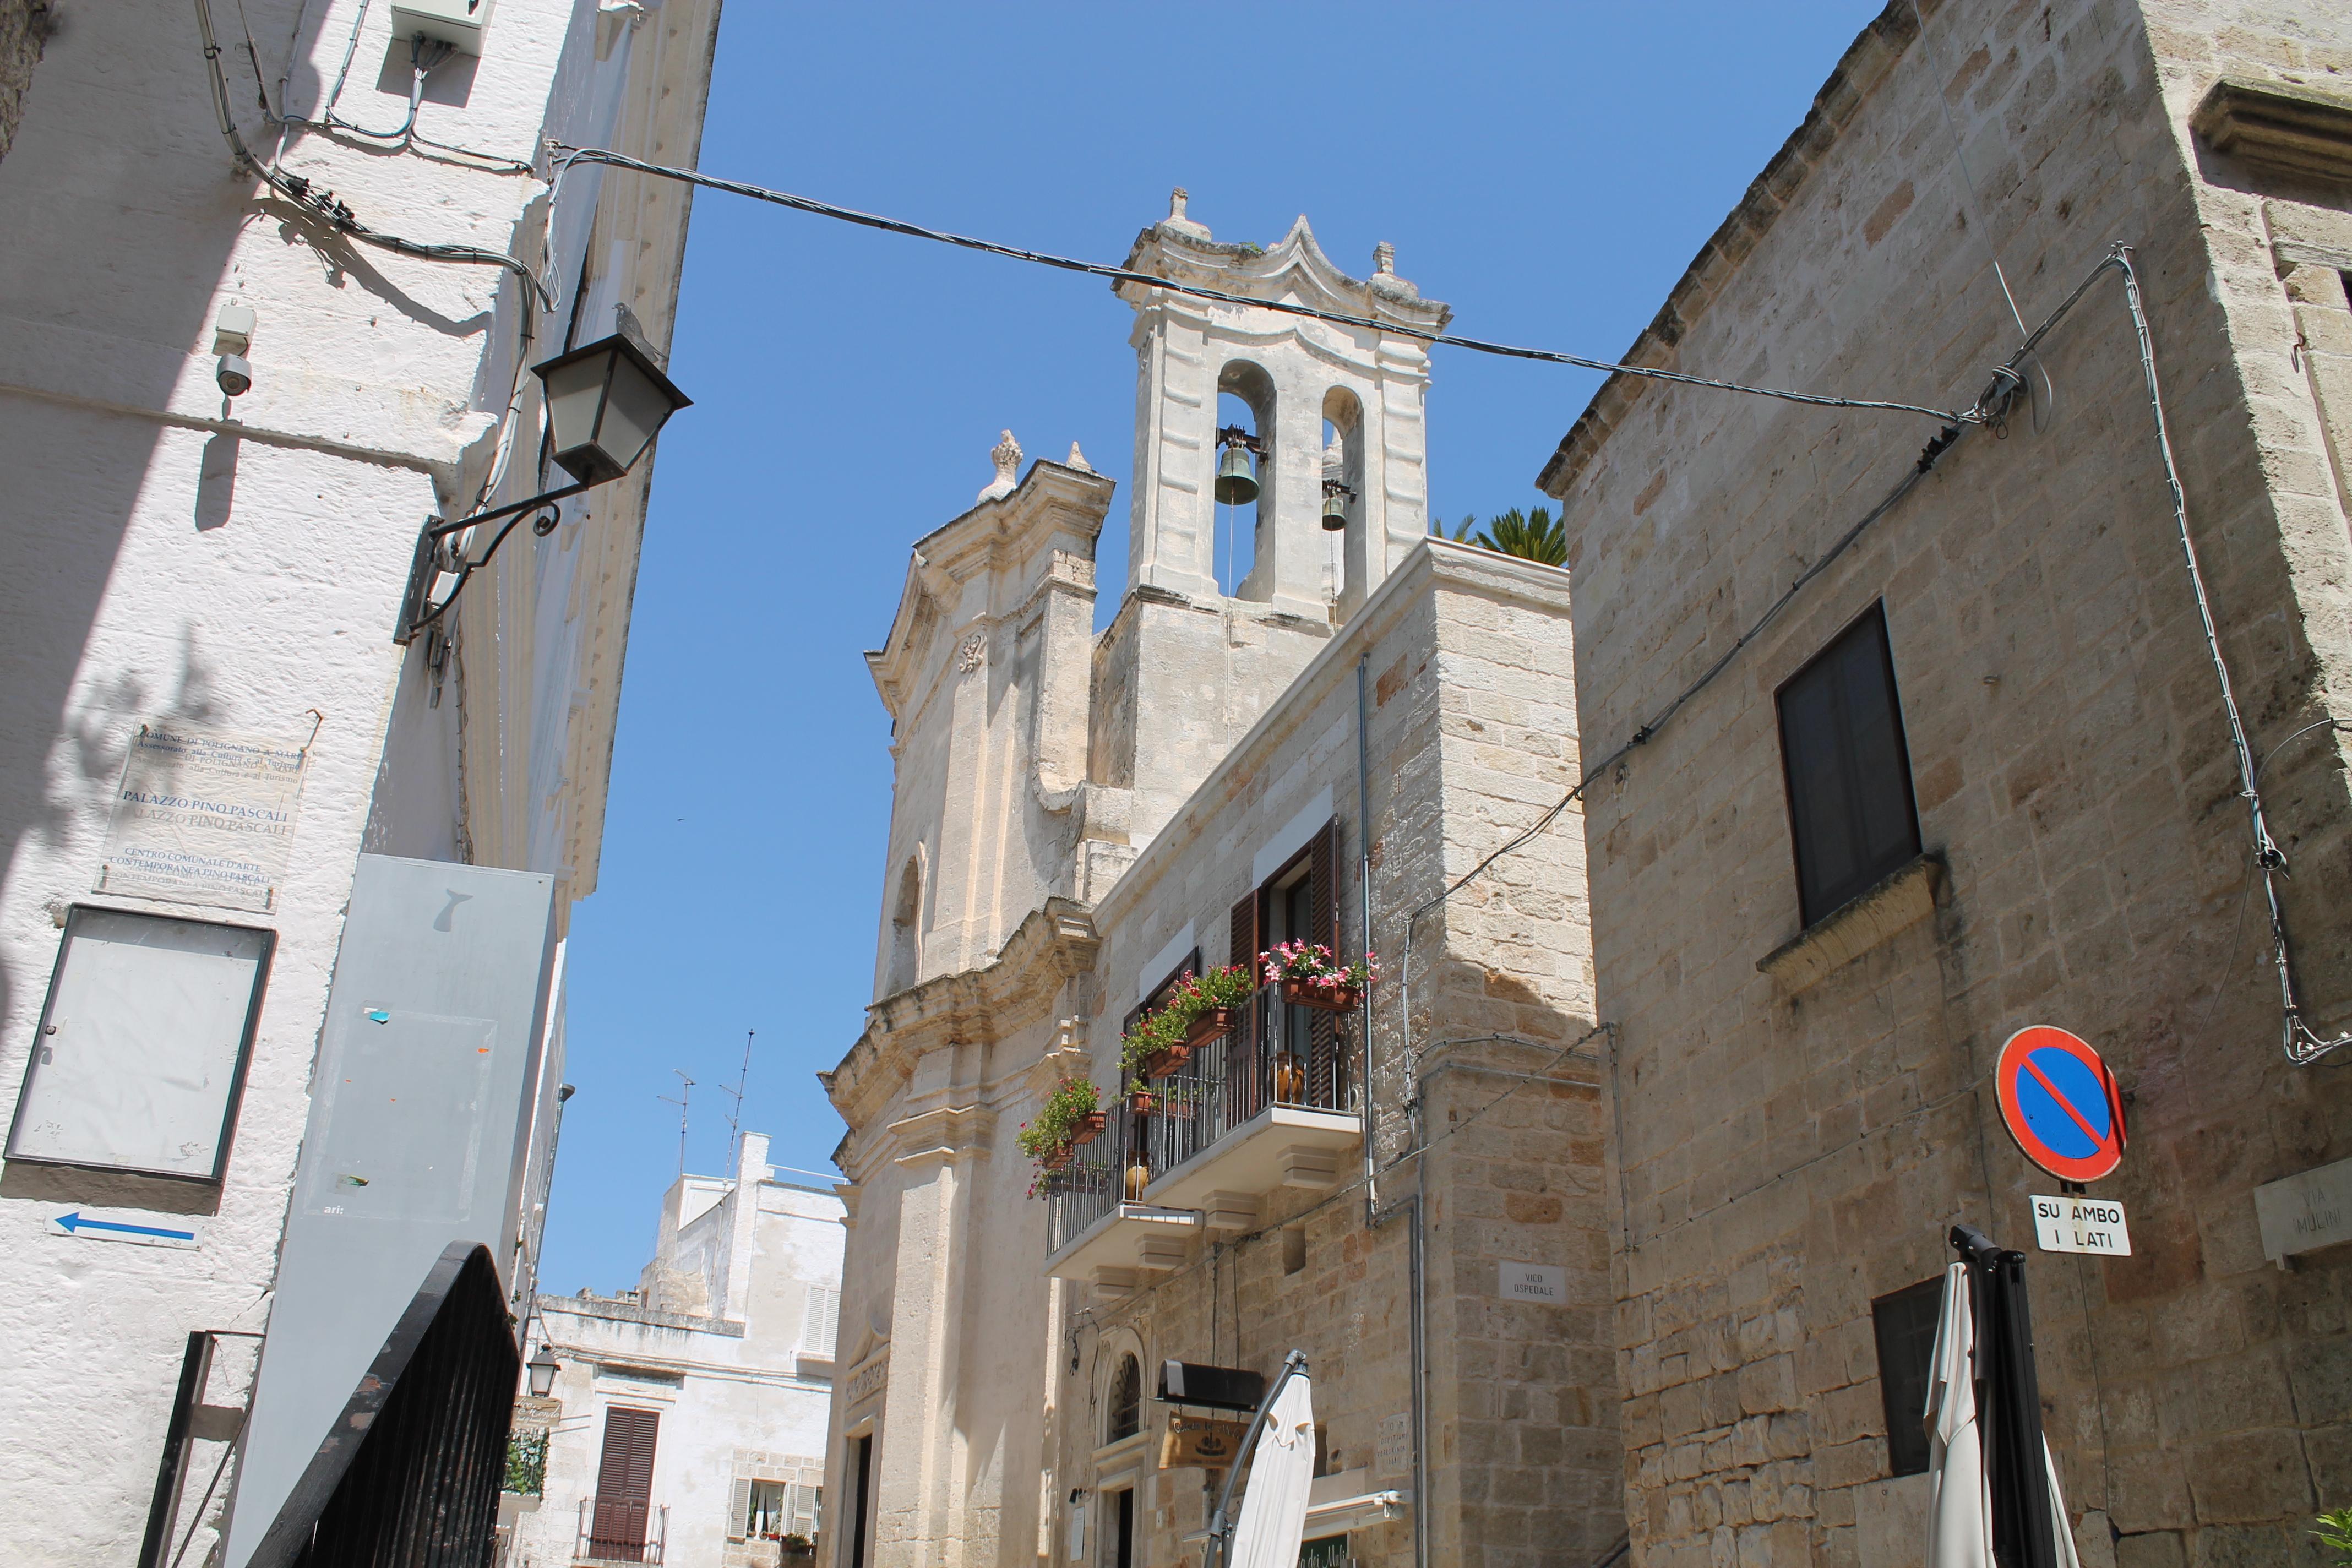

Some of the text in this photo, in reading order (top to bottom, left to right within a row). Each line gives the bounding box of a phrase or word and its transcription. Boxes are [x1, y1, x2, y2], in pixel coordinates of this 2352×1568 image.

[138, 741, 187, 753] Assessorato
[211, 750, 242, 761] Cultura
[268, 758, 300, 770] Turismo
[140, 732, 184, 743] COMUNE
[202, 739, 260, 754] POLIGNANO
[276, 750, 302, 760] MARE
[123, 790, 288, 822] PALAZZO PINO PASCALI
[110, 856, 271, 884] CONTEMPORANEA PINO PASCALI
[124, 847, 262, 872] CENTRO COMUNALE D'ARTE
[2038, 1202, 2120, 1224] SU AMBO
[2296, 1188, 2341, 1235] VIA MULINI
[2055, 1229, 2113, 1248] I LATI
[1514, 1273, 1554, 1295] VICO OSPEDALE
